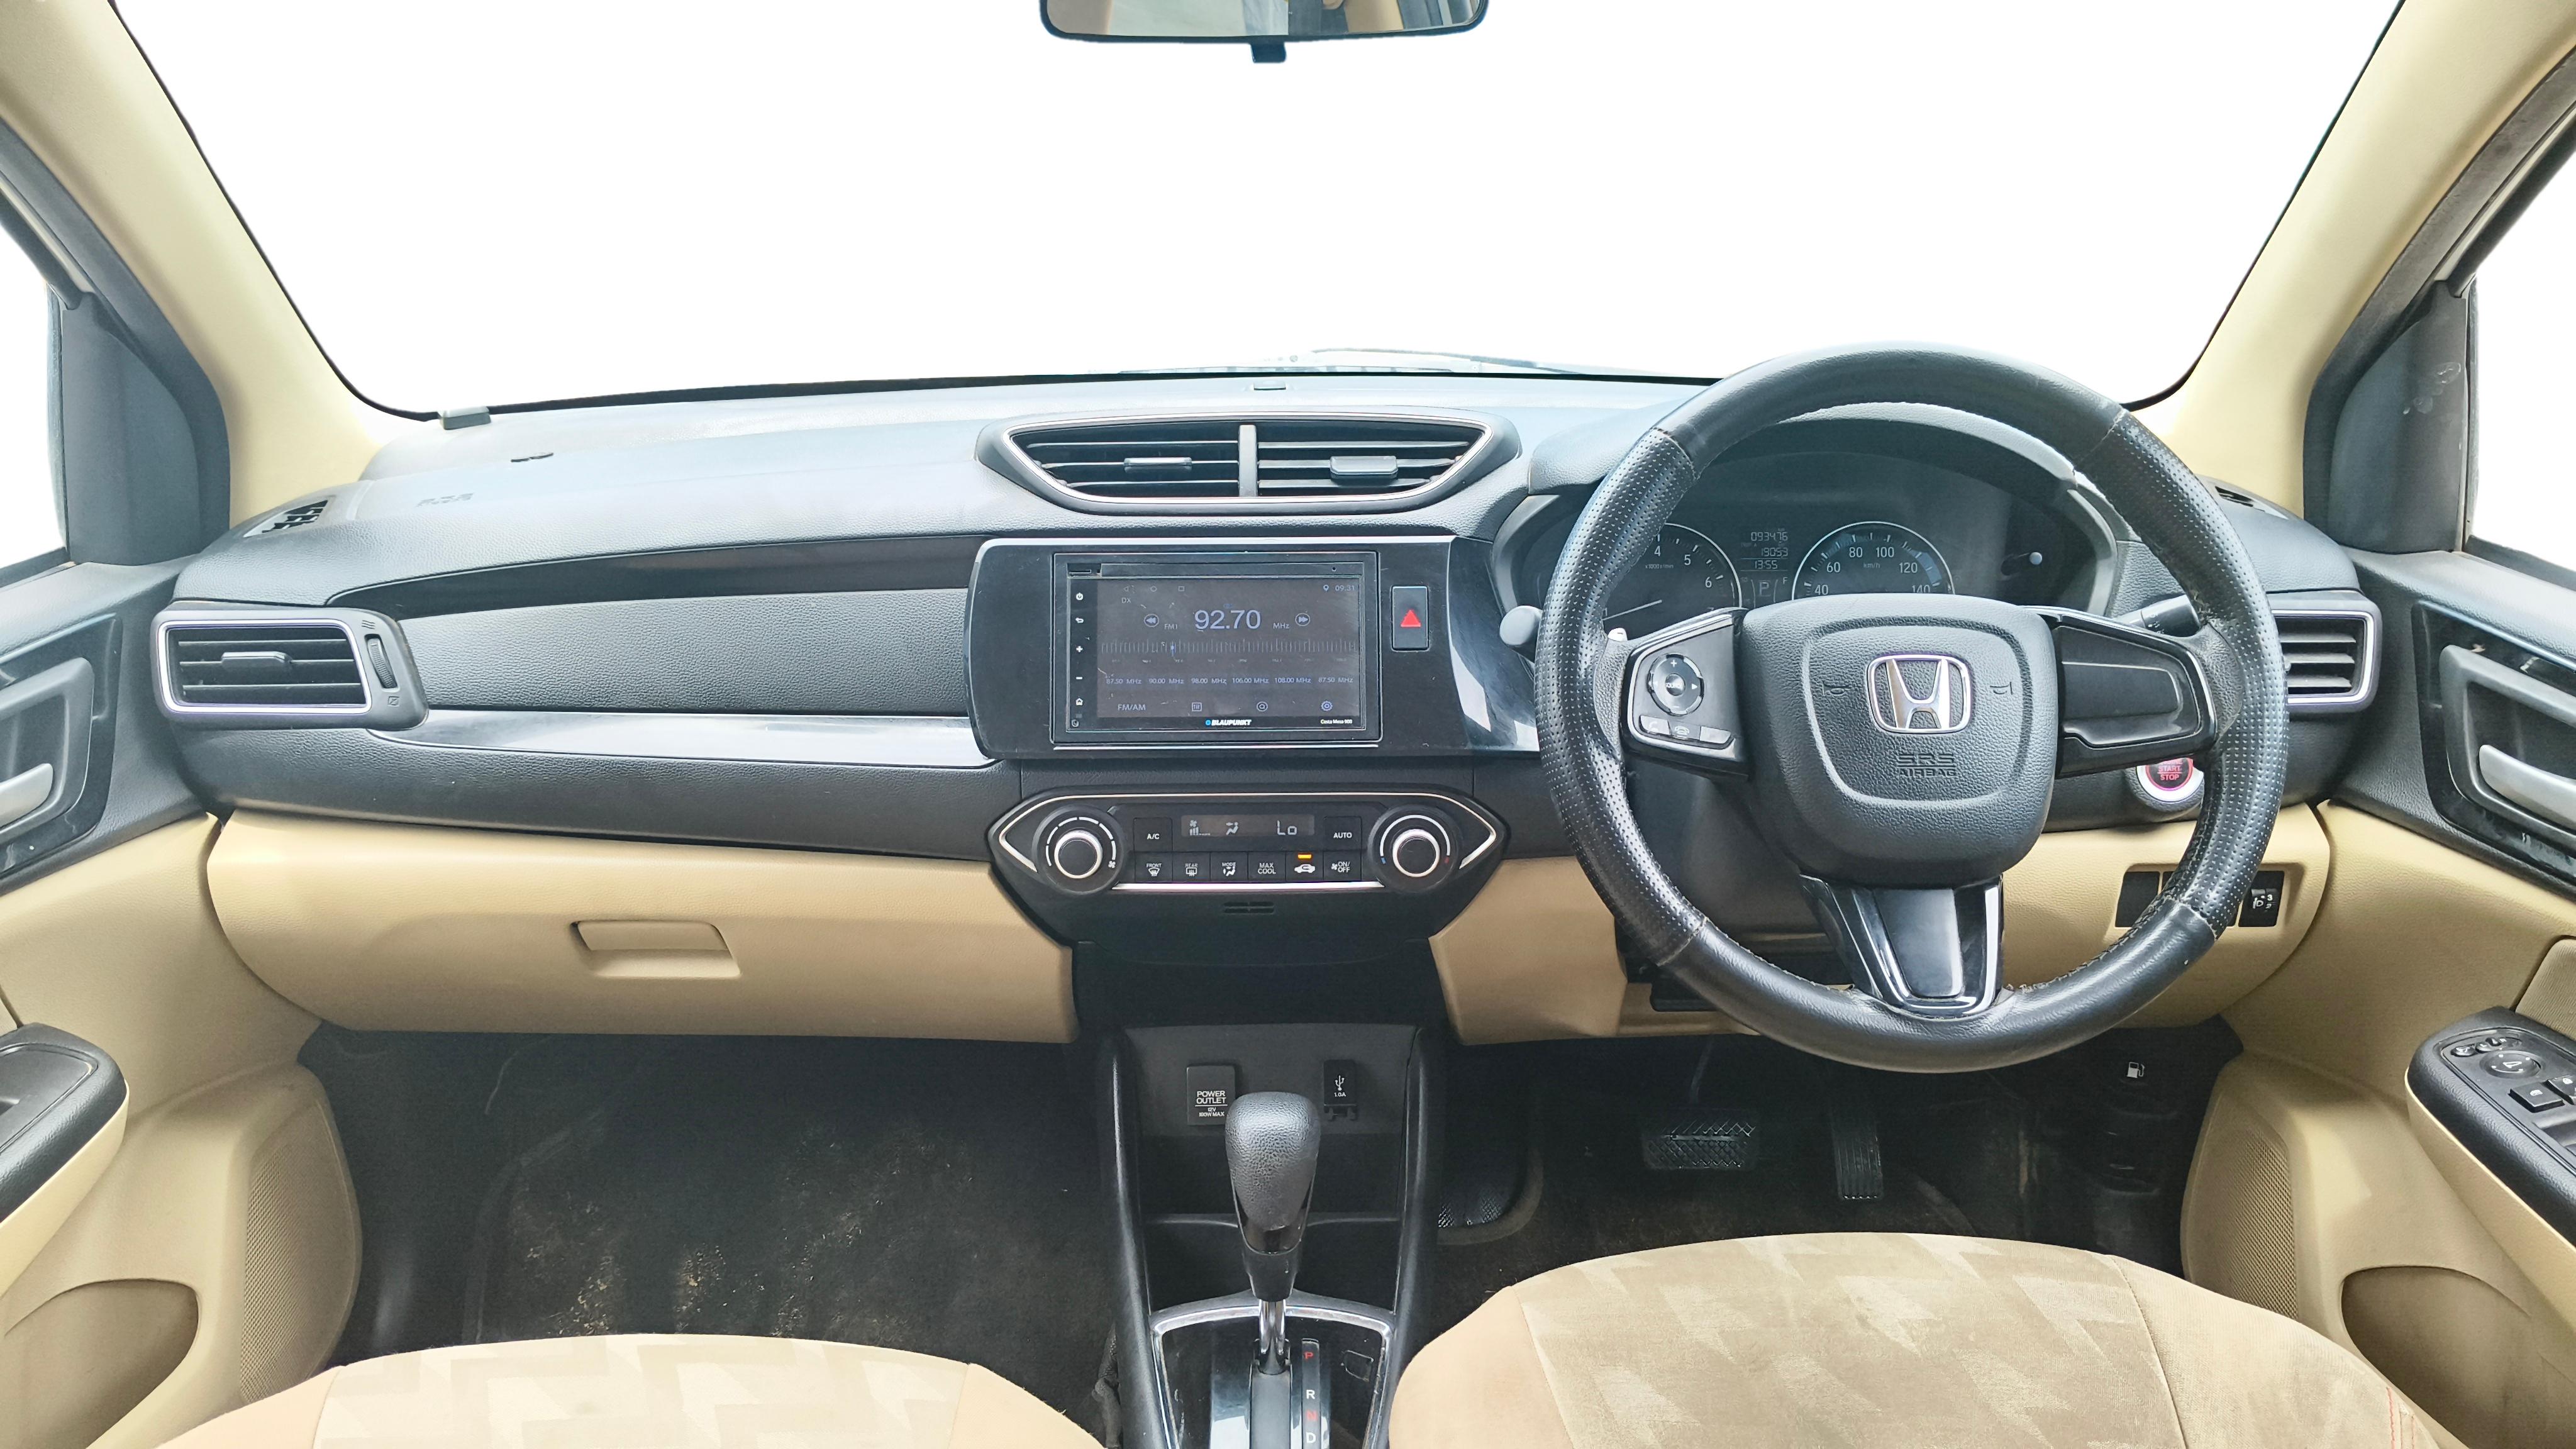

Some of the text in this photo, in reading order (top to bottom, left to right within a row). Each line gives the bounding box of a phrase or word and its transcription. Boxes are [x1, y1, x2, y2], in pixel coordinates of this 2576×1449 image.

[1654, 545, 1660, 557] 4
[1849, 547, 1863, 558] 80
[1876, 547, 1894, 558] 100
[1684, 554, 1690, 565] 5
[1755, 560, 1777, 569] 13:55
[1826, 562, 1841, 573] 60
[1899, 562, 1918, 573] 120
[1705, 577, 1712, 588] 6
[1814, 584, 1829, 596] 40
[1912, 584, 1930, 593] 140
[1195, 609, 1261, 630] 92.70
[1898, 769, 1957, 777] AIRBAG
[1277, 819, 1297, 835] Lo
[1306, 1390, 1315, 1399] R
[1306, 1411, 1317, 1421] N
[1306, 1432, 1316, 1443] D
